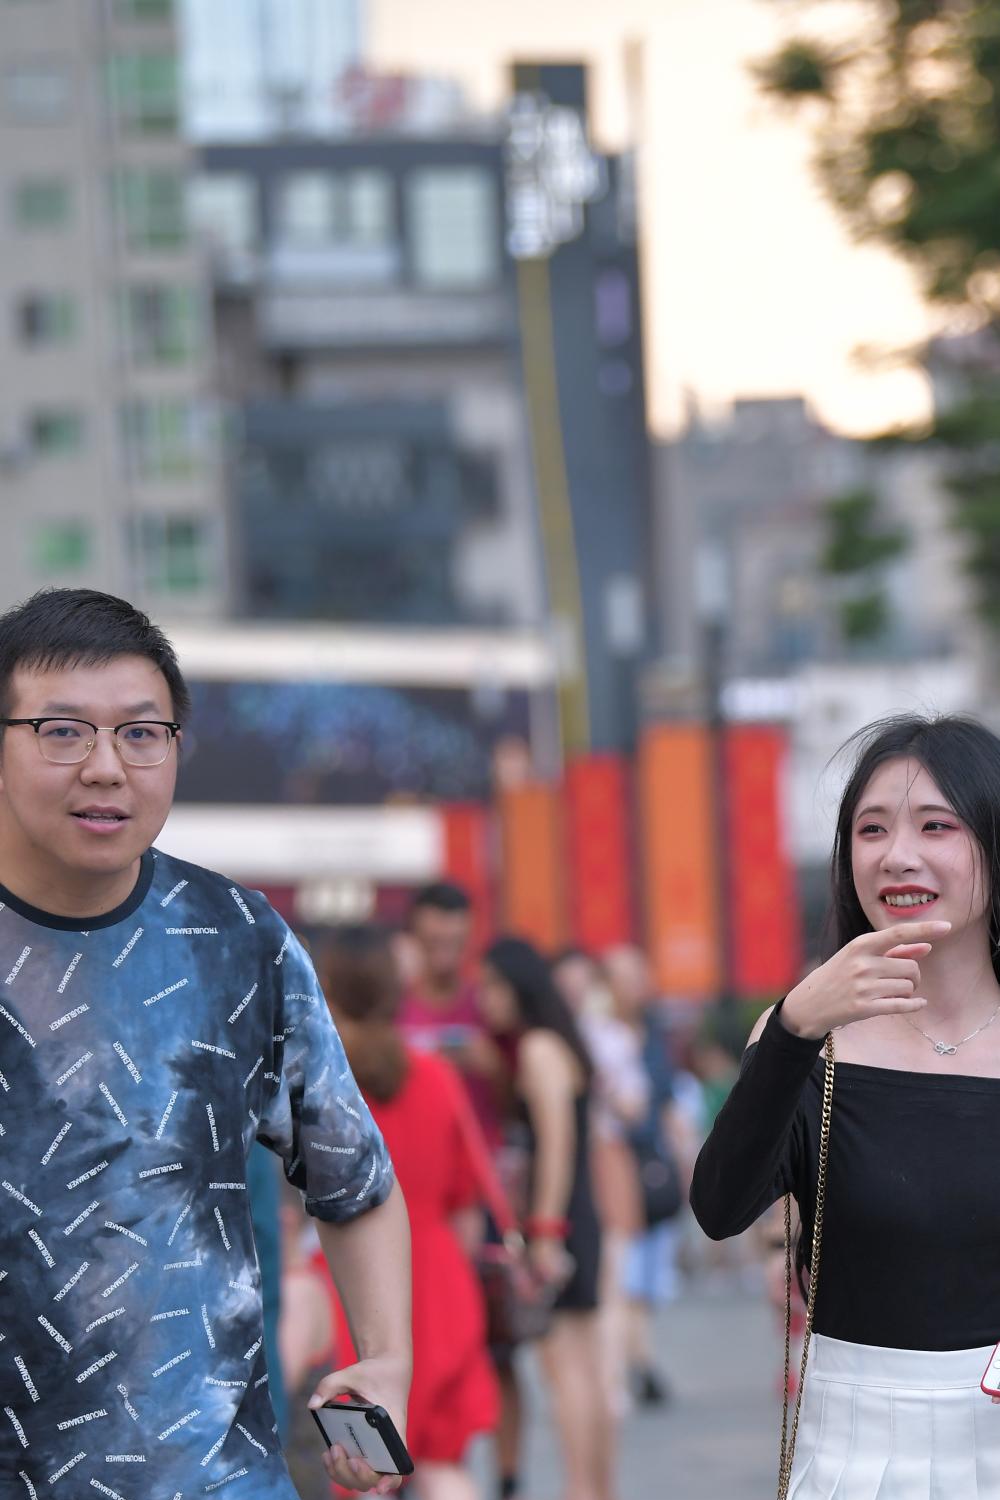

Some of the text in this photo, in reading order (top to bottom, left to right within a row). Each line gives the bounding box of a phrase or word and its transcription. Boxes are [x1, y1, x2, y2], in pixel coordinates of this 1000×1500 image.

[111, 927, 145, 969] TROUBLEMAKER
[164, 926, 220, 935] TROUBLEMAKER
[4, 945, 33, 985] TROUBLEMAKER
[56, 952, 83, 994] TROUBLEMAKER
[142, 978, 189, 1007] TROUBLEMAKER
[0, 1003, 37, 1049] TROUBLEMAKE
[48, 1002, 91, 1032] TROUBLEMAKER
[55, 1050, 94, 1086] TROUBLEMAKER
[112, 1040, 143, 1085] TROUBLEMAKER
[191, 1039, 237, 1060] TROUBLEMAKER
[98, 1081, 129, 1128] TROUBLEMAKER
[154, 1090, 179, 1141] TROUBLEMAKER
[39, 1121, 73, 1166] TROUBLEMAKER
[205, 1102, 220, 1153] TROUBLEMAKER
[65, 1159, 110, 1190] TROUBLEMAKER
[138, 1162, 184, 1179] TROUBLEMAKER
[1, 1179, 44, 1217] TROUBLEMAKER
[62, 1200, 101, 1236] TROUBLEMAKER
[103, 1220, 148, 1247] TROUBLEMAKER
[27, 1228, 57, 1269] TROUBLEMAKER
[52, 1261, 91, 1302] TROUBLEMAKER
[100, 1261, 140, 1298] TROUBLEMAKER
[37, 1314, 74, 1355] TROUBLEMAKER
[200, 1303, 216, 1350] TROUBLEMAKER
[13, 1354, 41, 1403] TROUBLEMAKER
[74, 1349, 119, 1384] TROUBLEMAKER
[151, 1348, 192, 1378] TROUBLEMAKER
[3, 1405, 31, 1449] TROUBLEMAKER
[56, 1408, 109, 1431] TROUBLEMAKER
[157, 1408, 202, 1441] TROUBLEMAKER
[47, 1450, 88, 1485] TROUBLEMAKER
[104, 1454, 147, 1463] TROUBLEMAKER
